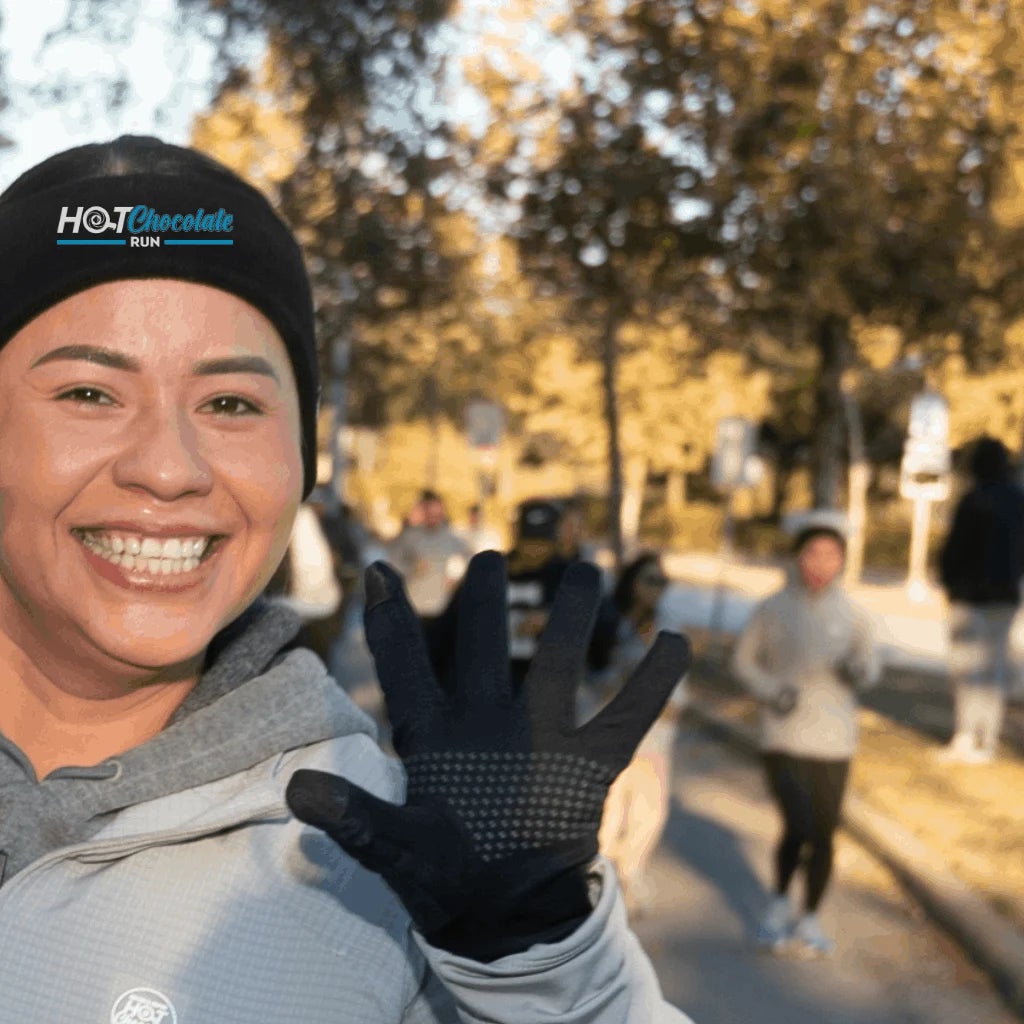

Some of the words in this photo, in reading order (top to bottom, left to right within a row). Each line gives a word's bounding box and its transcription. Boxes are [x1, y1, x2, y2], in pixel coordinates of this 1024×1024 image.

[57, 206, 134, 234] HOT
[127, 205, 233, 234] Chocolate
[130, 236, 160, 247] RUN
